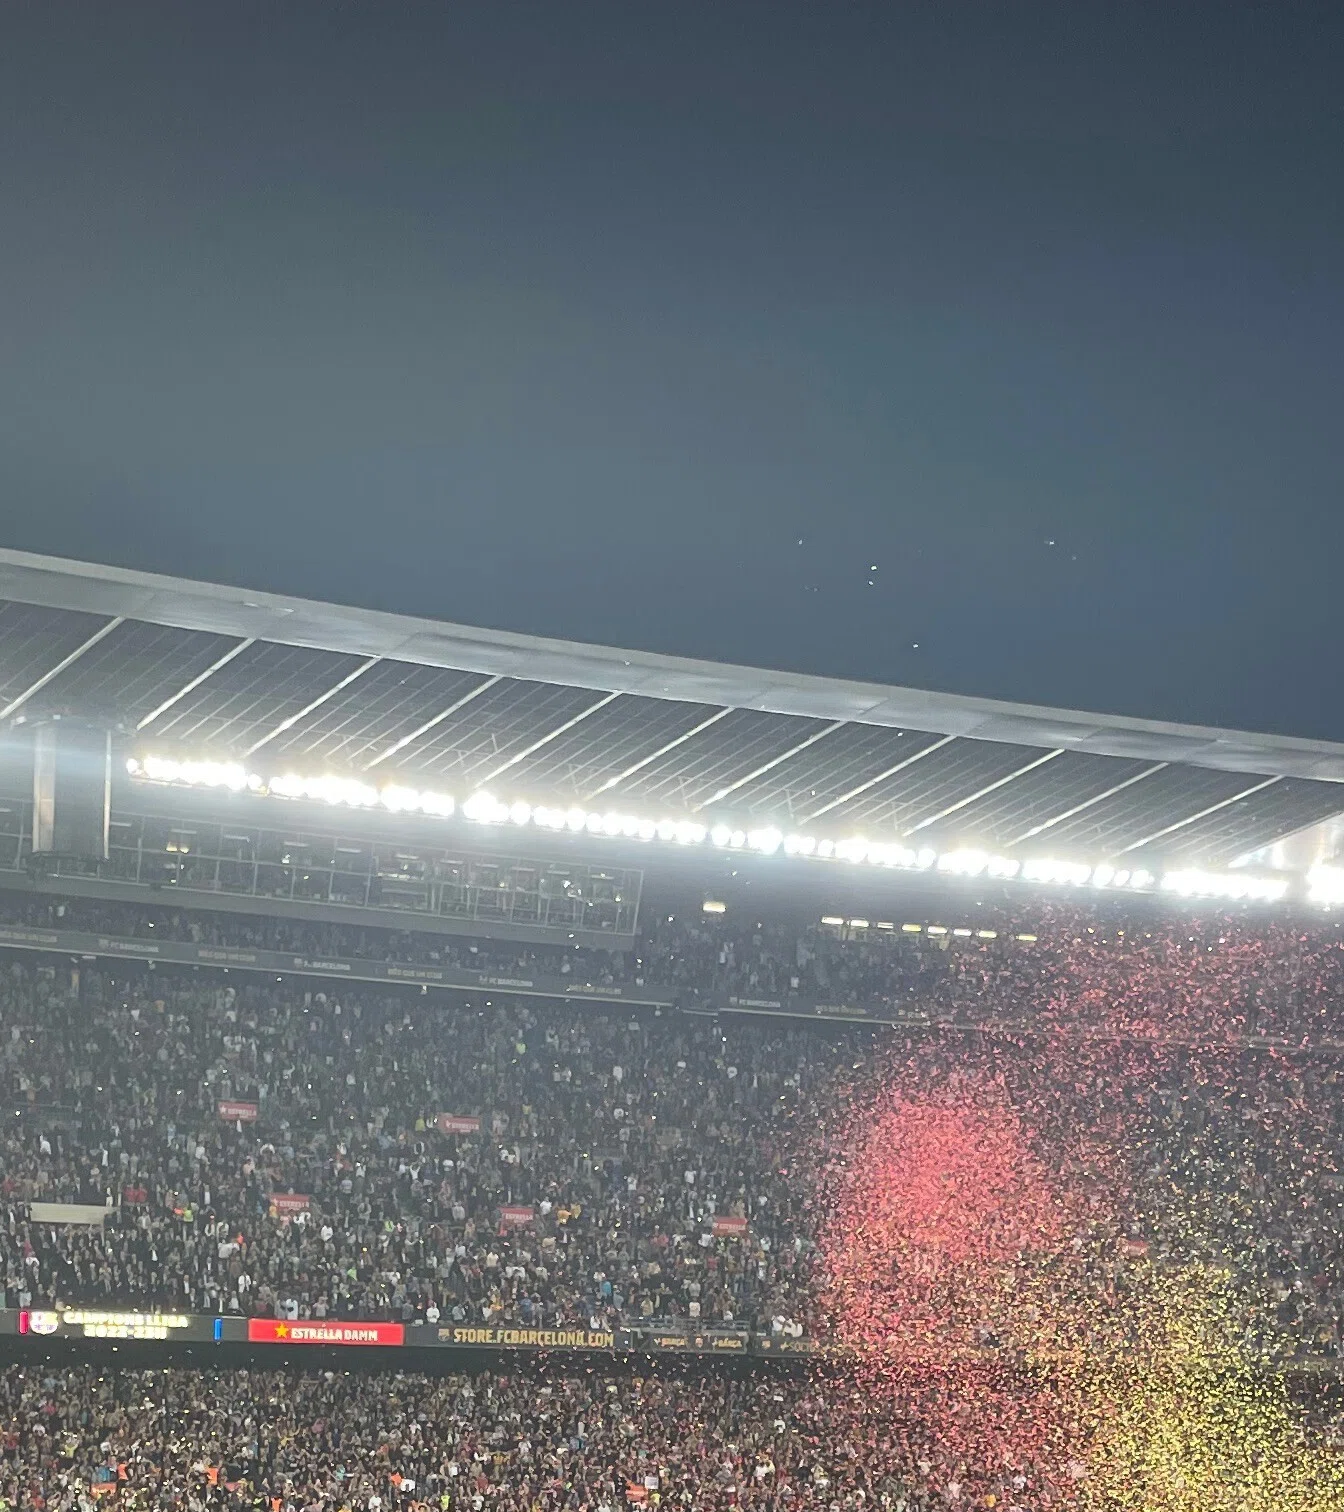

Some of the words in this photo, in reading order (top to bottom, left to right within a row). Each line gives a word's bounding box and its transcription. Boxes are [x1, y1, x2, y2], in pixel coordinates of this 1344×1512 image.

[290, 1327, 343, 1341] ESTRELLA
[344, 1329, 378, 1342] DAMM
[453, 1328, 615, 1347] STORE.FCBARCELONA.COM
